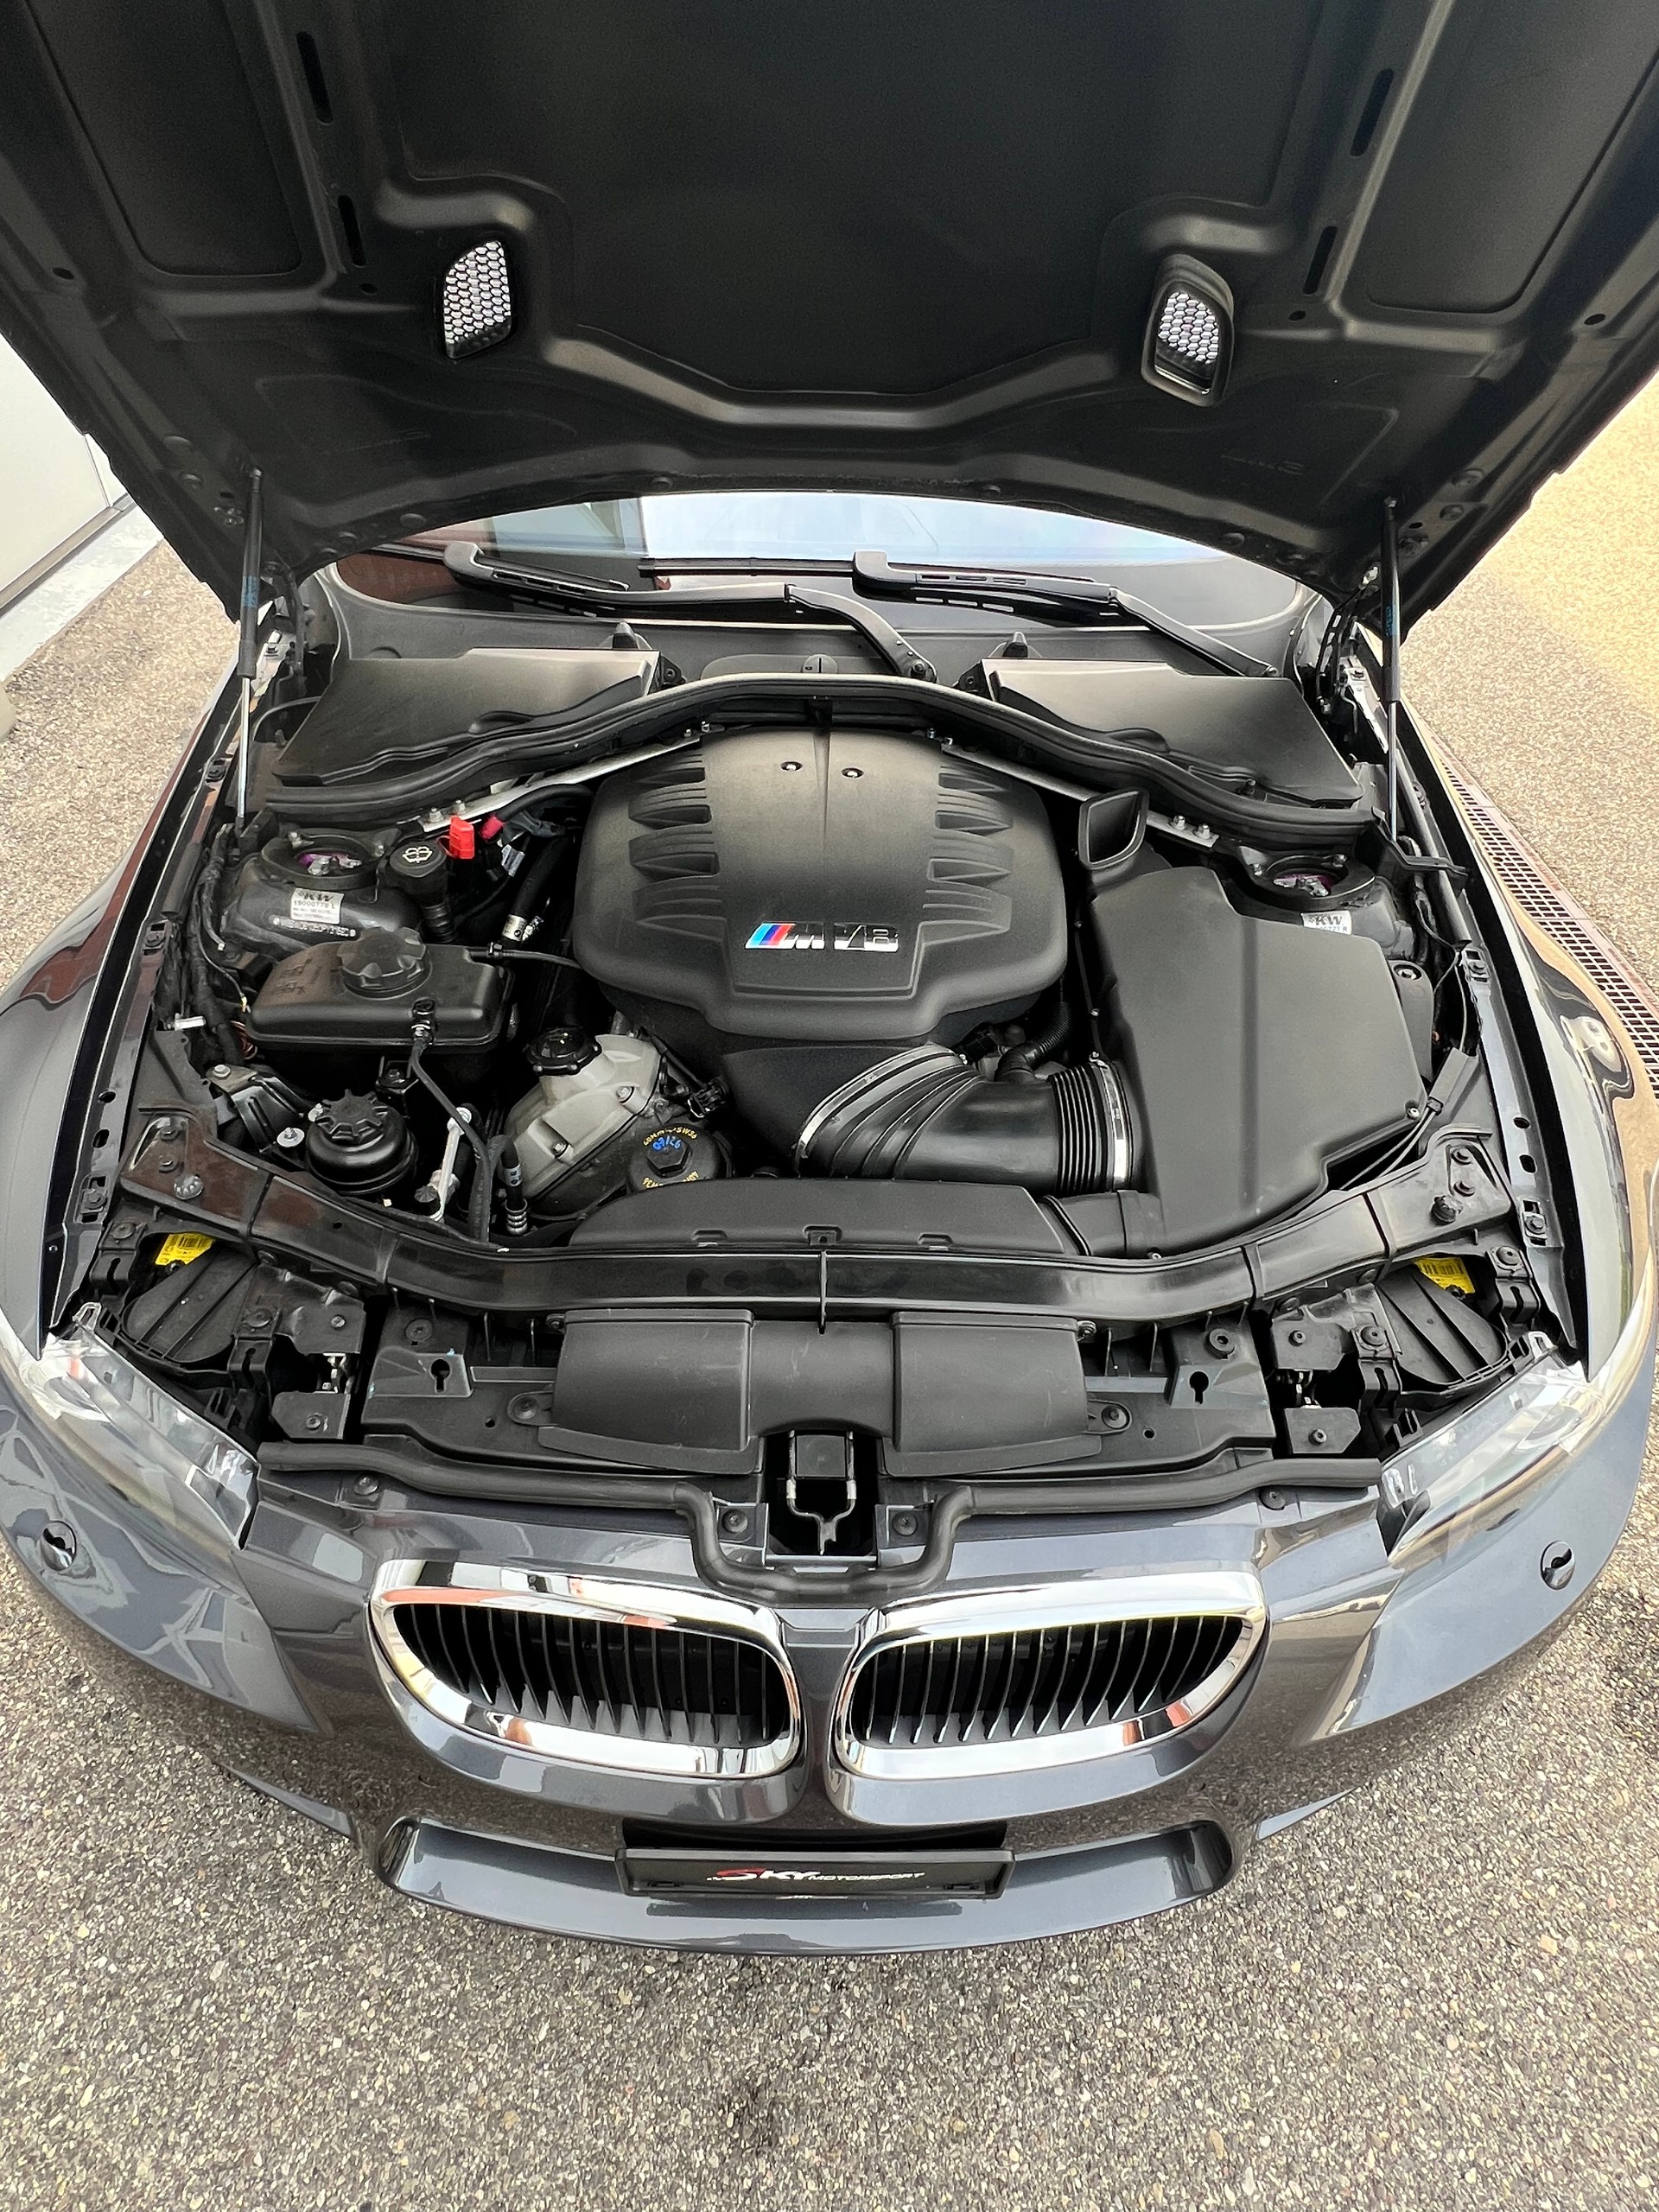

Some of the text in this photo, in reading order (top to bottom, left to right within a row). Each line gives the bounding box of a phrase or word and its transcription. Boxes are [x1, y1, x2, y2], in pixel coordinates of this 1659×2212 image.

[1315, 915, 1343, 925] KW
[834, 922, 899, 952] V8
[709, 1866, 821, 1881] SKY
